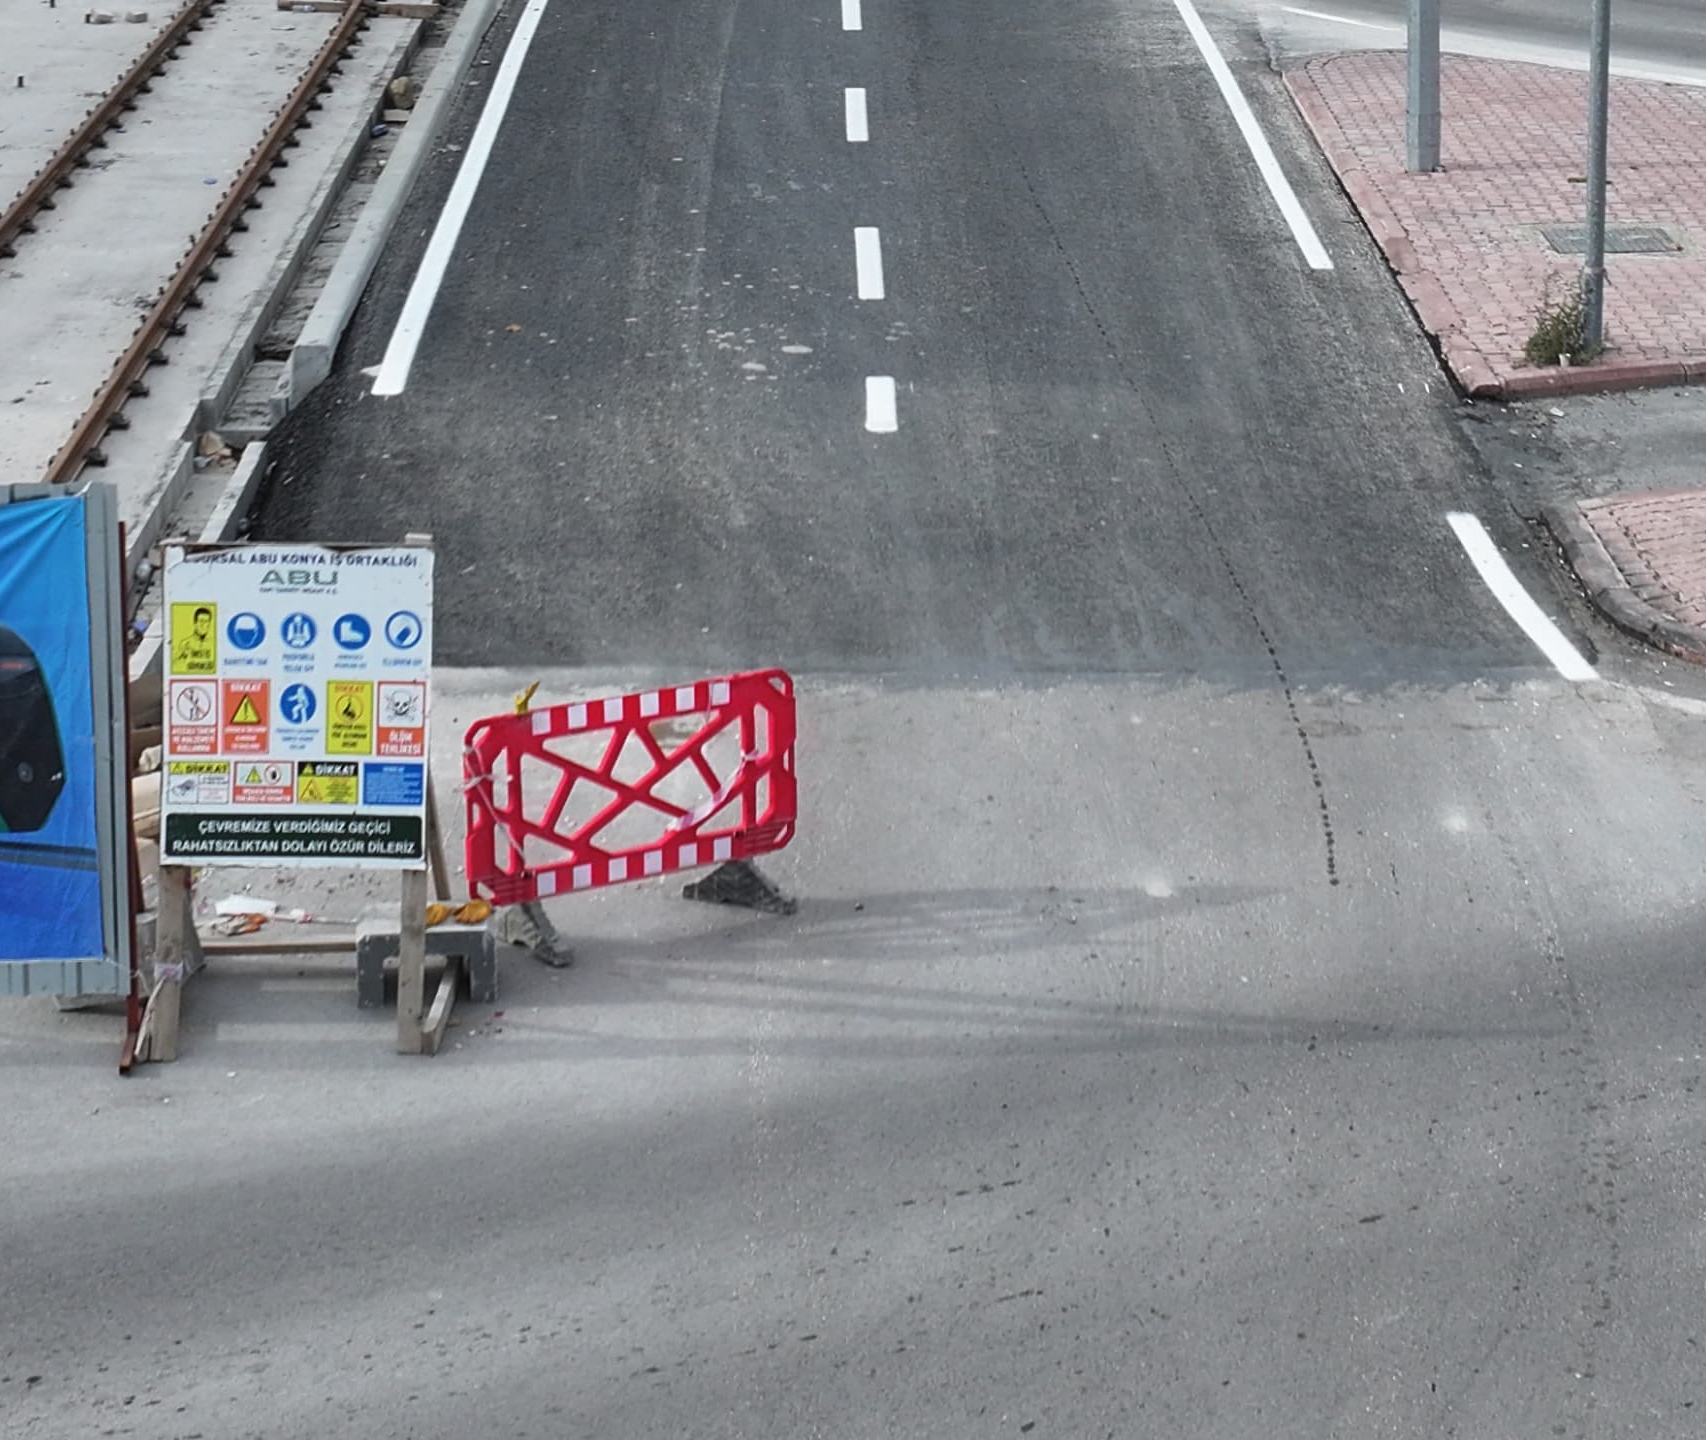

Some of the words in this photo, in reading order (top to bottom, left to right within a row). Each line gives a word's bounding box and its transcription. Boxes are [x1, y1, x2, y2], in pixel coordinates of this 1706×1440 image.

[280, 553, 325, 565] KONYA
[345, 554, 418, 567] ORTAKLIĞI
[259, 569, 339, 586] ABU
[315, 762, 356, 776] DİKKAT
[197, 818, 270, 836] ÇEVREMİZE
[273, 818, 345, 834] VERDİĞİMİZ
[347, 820, 391, 837] GEÇİCİ
[172, 839, 279, 853] RAHATSIZLIKTAN
[281, 840, 327, 852] DOLAYI
[329, 838, 365, 853] ÖZÜR
[367, 840, 416, 854] DİLERİZ
